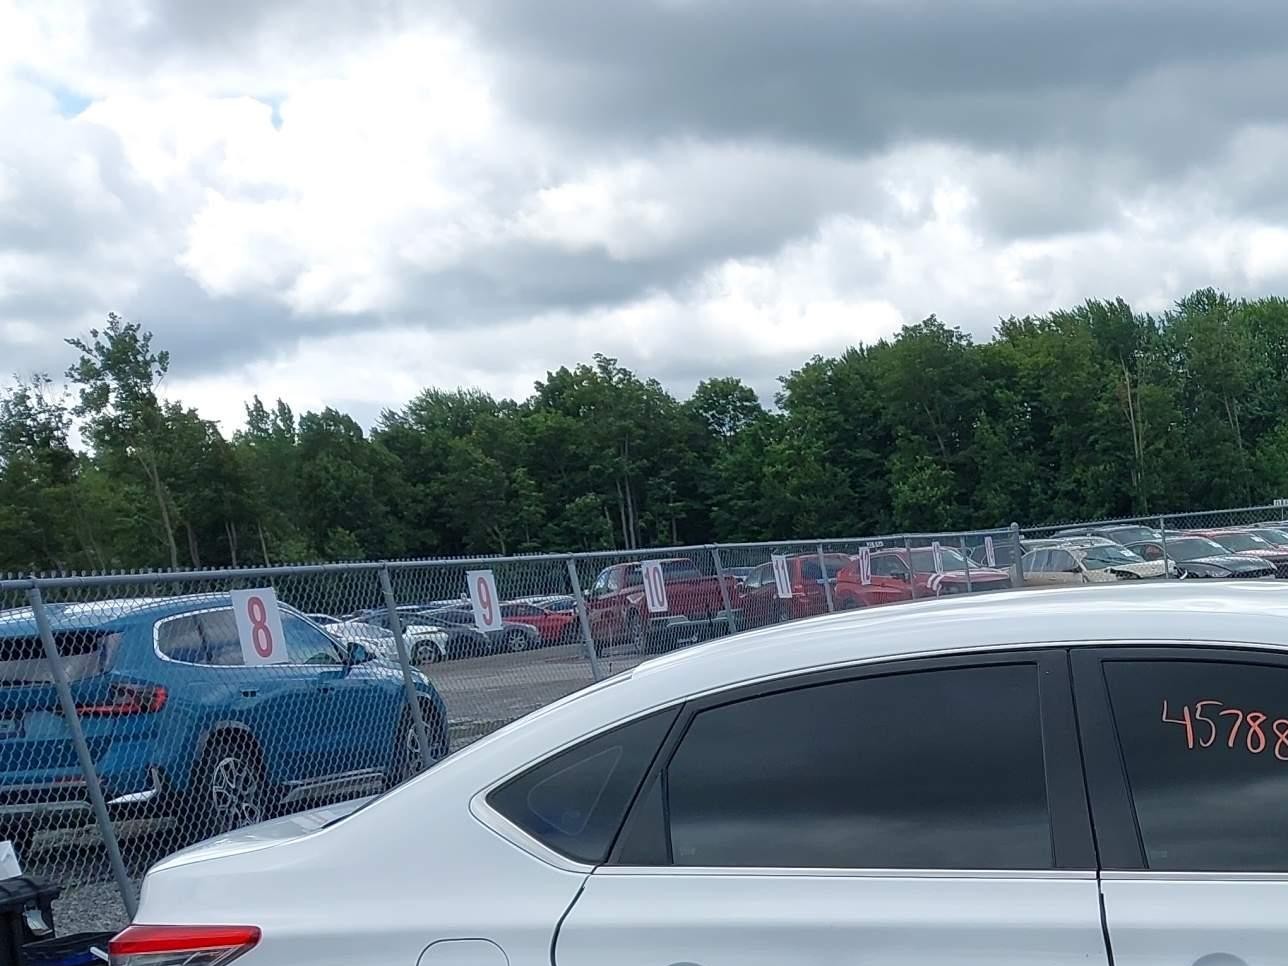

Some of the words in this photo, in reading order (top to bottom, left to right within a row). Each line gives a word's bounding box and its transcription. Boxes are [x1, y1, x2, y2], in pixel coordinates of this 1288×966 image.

[645, 566, 665, 607] 10
[774, 558, 790, 595] 11
[477, 576, 493, 625] 9
[248, 597, 273, 657] 8
